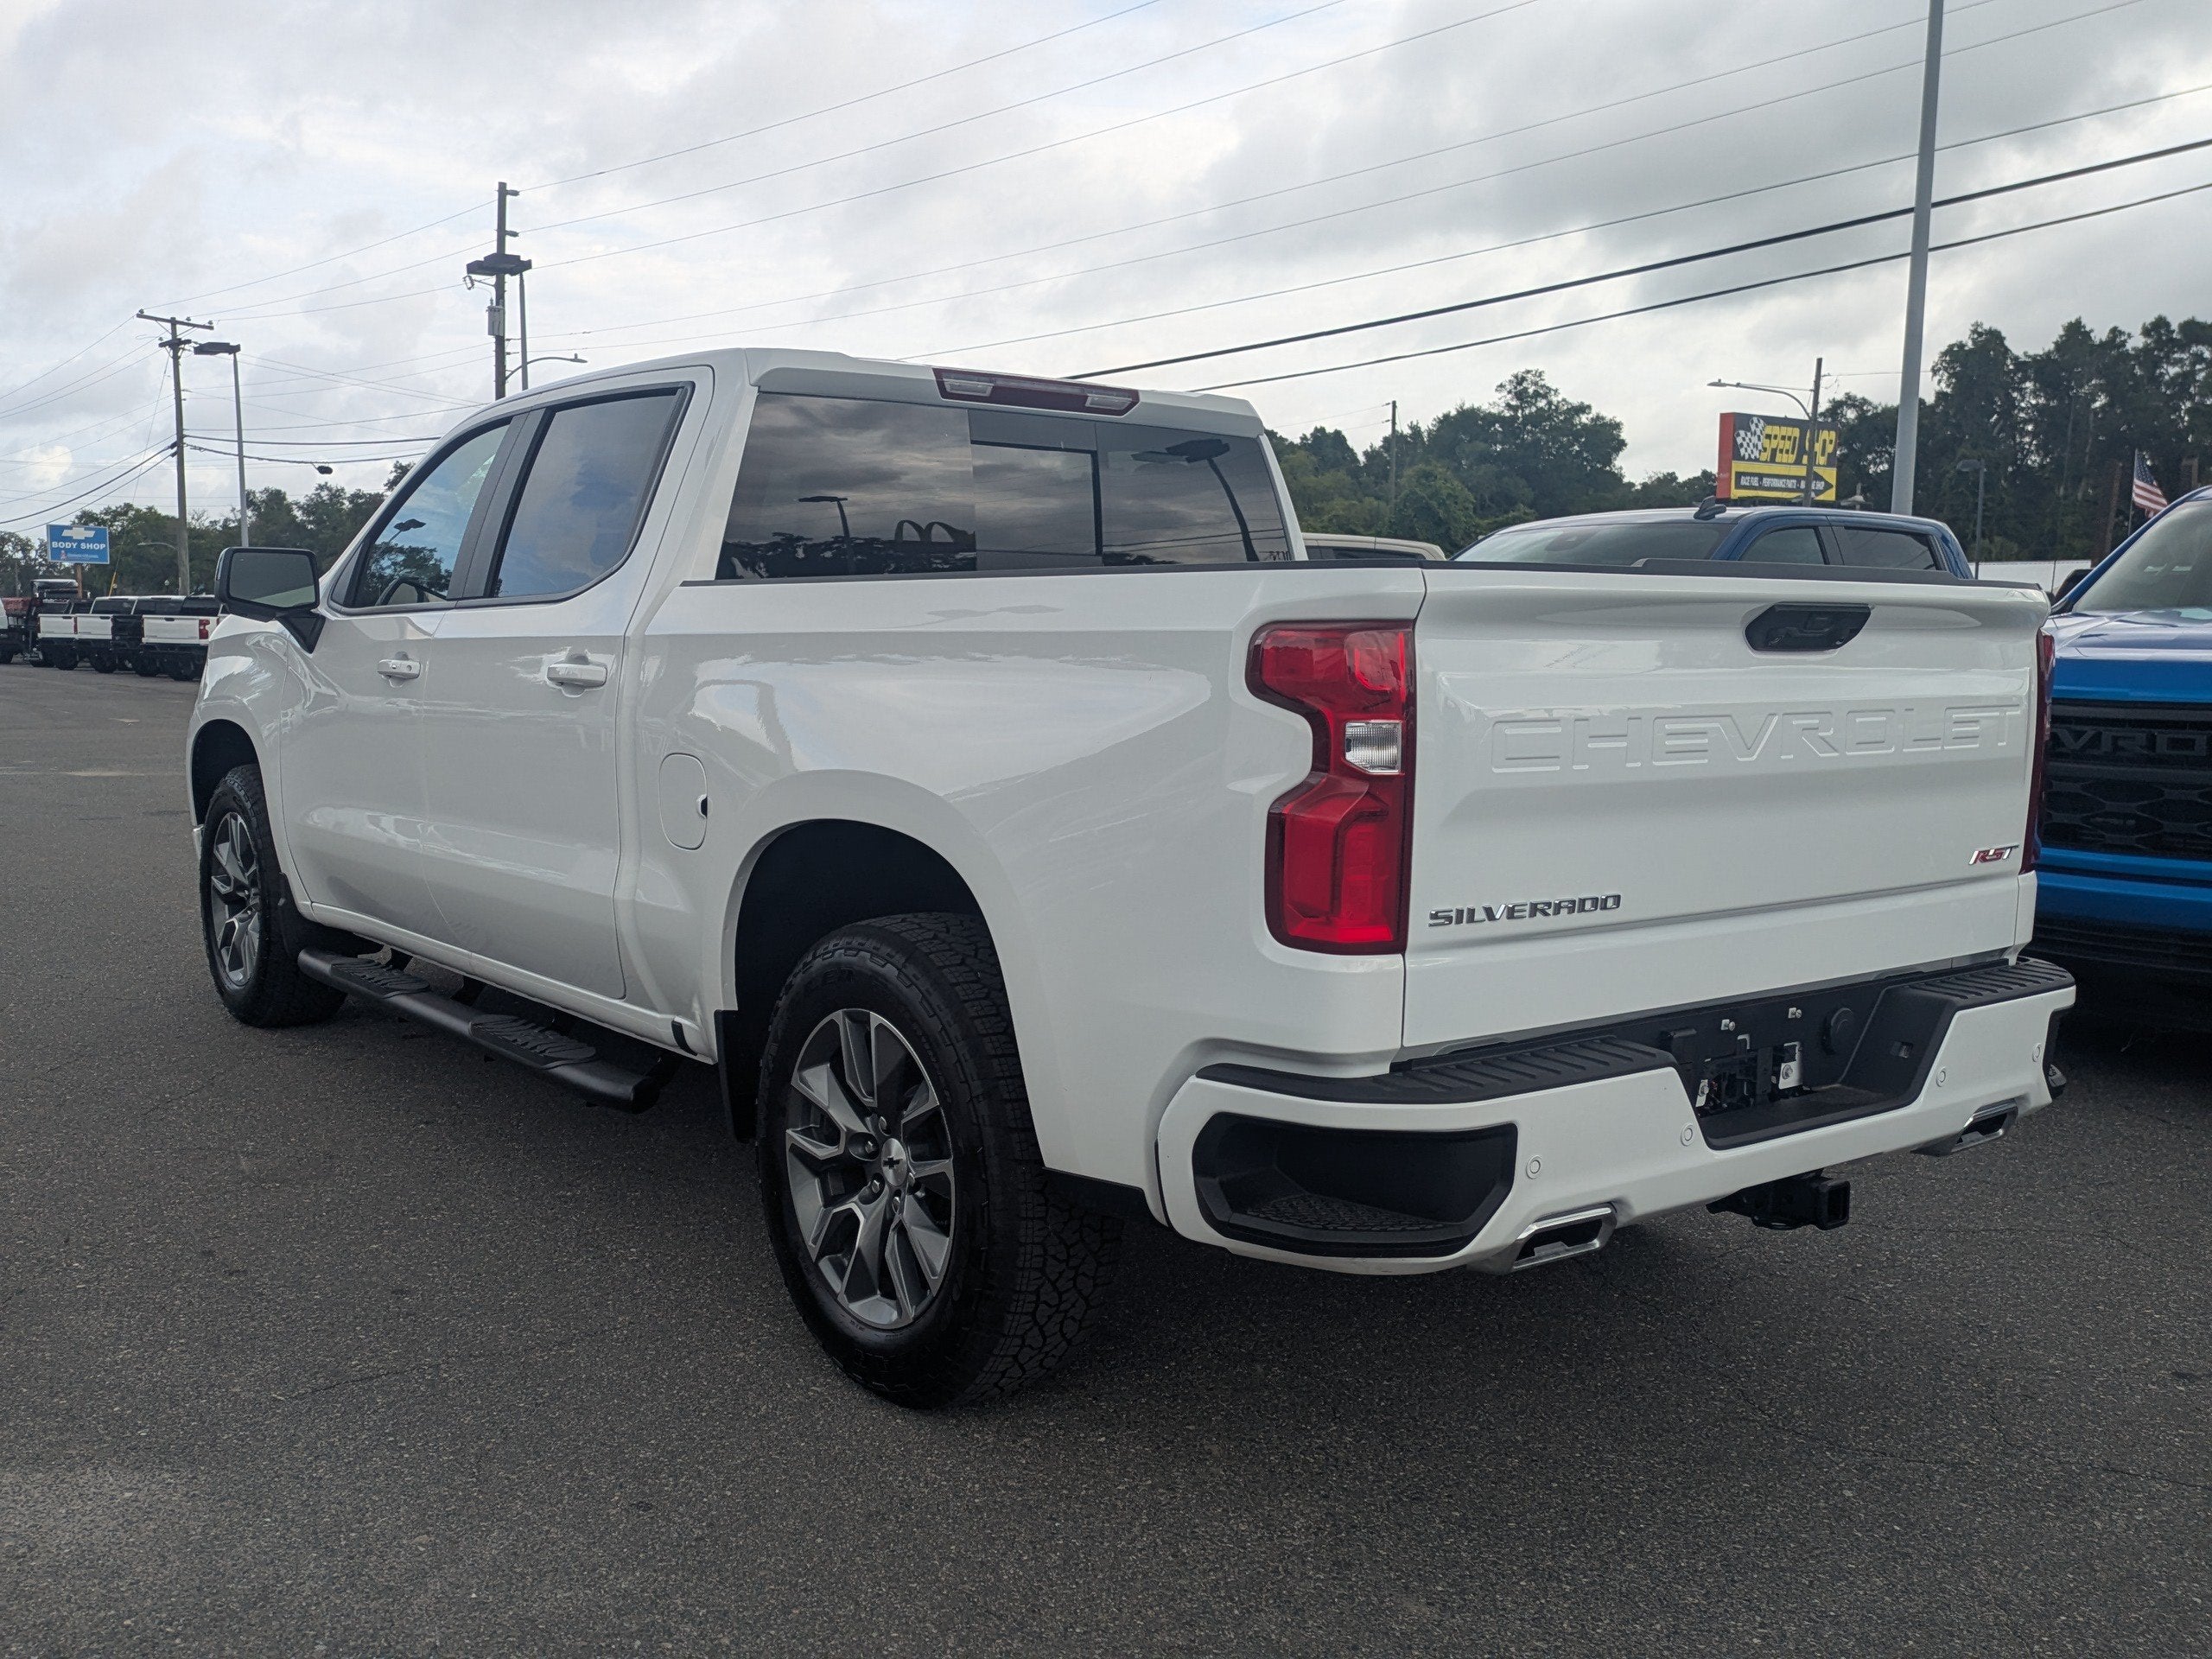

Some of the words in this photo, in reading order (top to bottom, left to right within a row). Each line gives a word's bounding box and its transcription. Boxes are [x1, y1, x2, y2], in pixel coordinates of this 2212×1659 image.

[1759, 424, 1800, 464] SPEED
[1491, 704, 2022, 773] CHEVROLET
[1968, 844, 2019, 865] RST
[1428, 893, 1621, 927] SILVERADO
